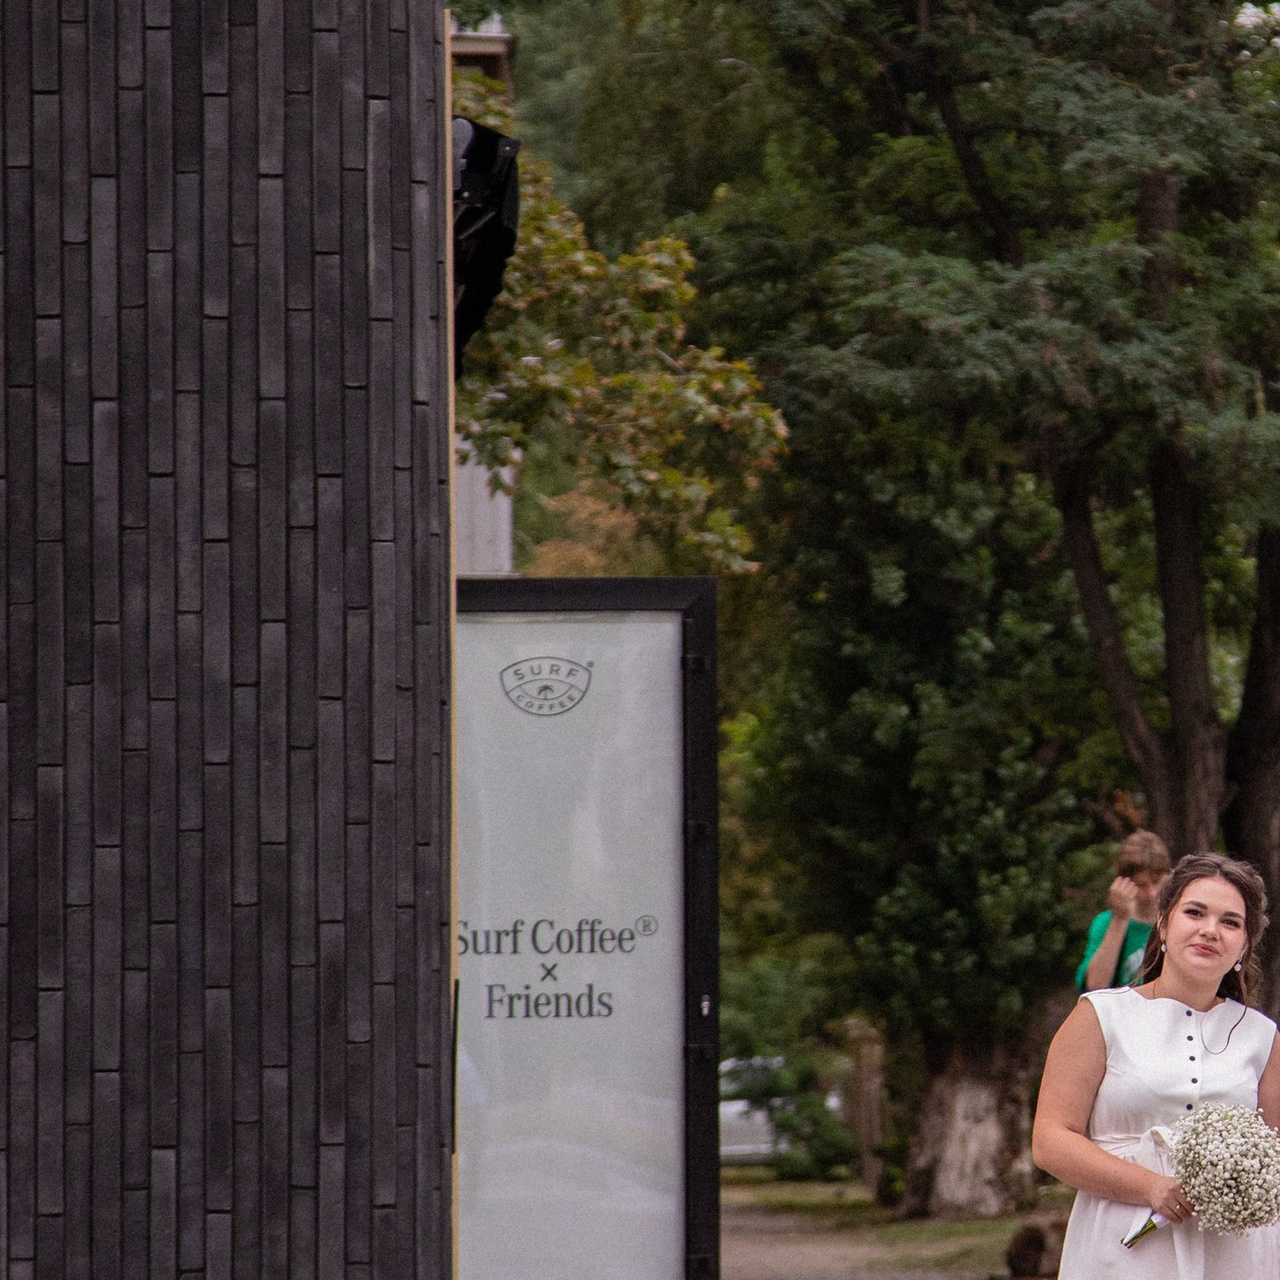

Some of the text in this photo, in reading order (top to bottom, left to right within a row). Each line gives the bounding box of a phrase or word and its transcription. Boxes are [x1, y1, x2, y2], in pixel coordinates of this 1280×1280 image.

[513, 664, 579, 681] SURF
[516, 694, 576, 711] COFFEE
[459, 919, 524, 955] Surf
[485, 983, 612, 1018] Friends
